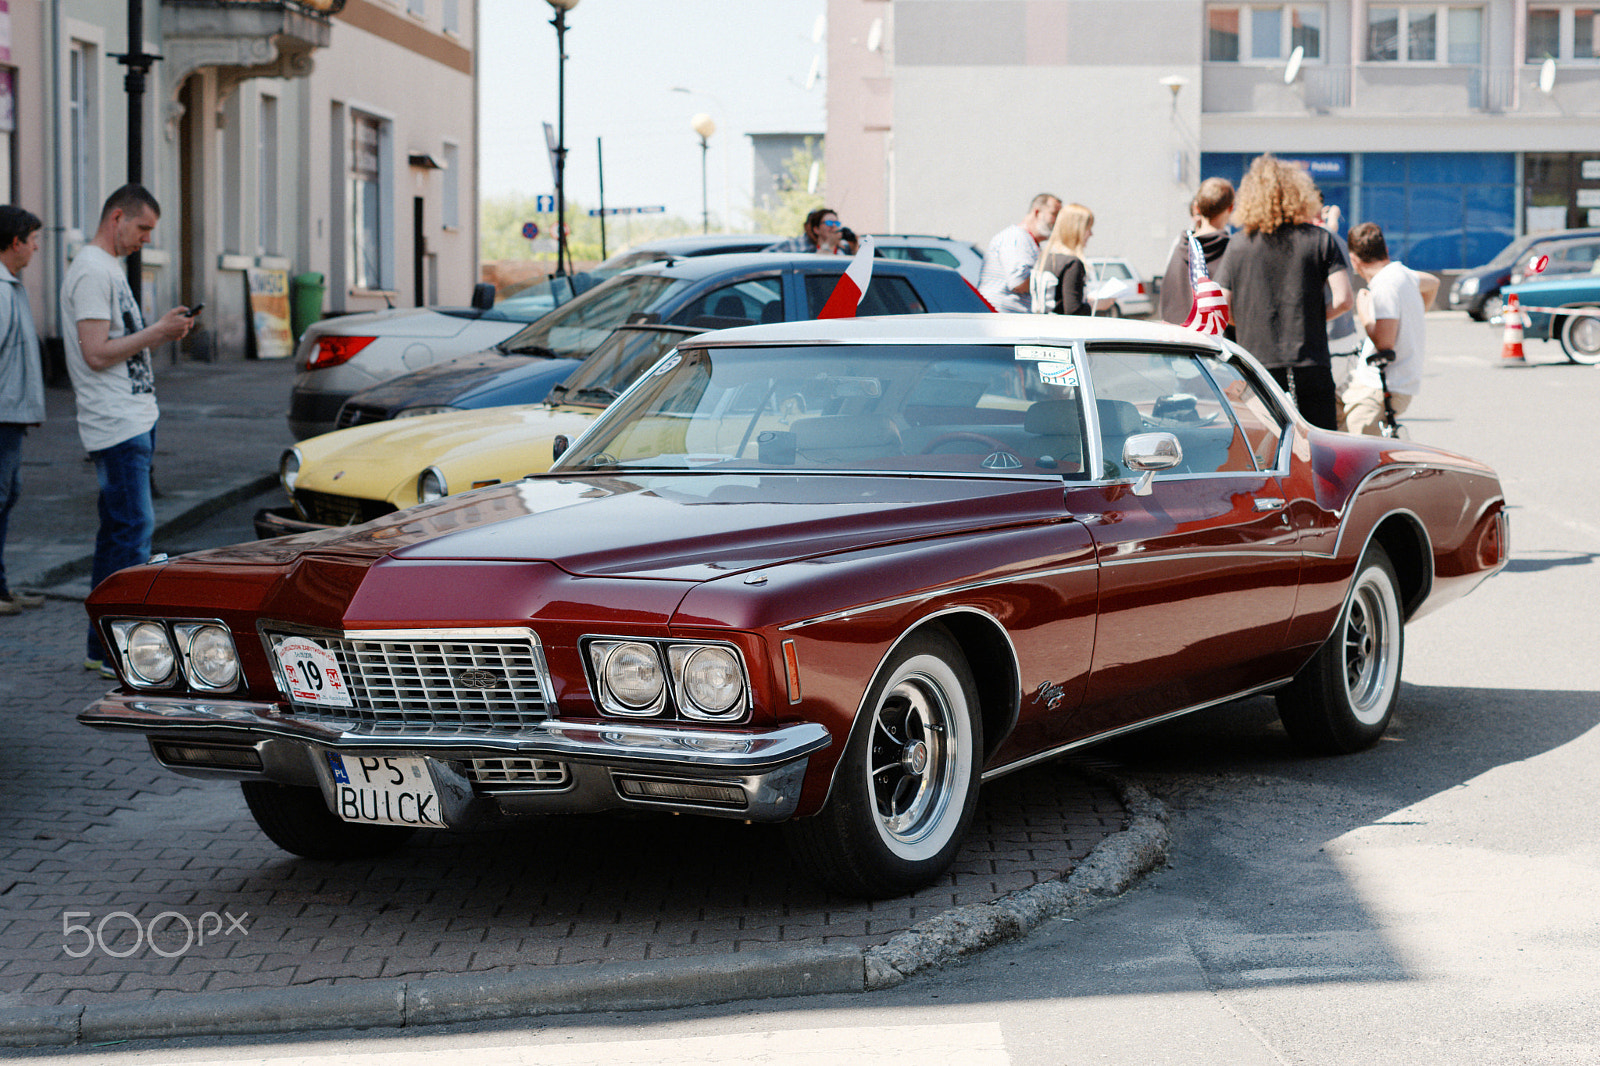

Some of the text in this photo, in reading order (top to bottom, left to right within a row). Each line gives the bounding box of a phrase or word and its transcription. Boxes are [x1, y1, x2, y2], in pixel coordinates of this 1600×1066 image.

[297, 660, 323, 690] 19
[335, 769, 347, 779] PL
[359, 757, 404, 785] P5
[342, 787, 438, 825] BUICK
